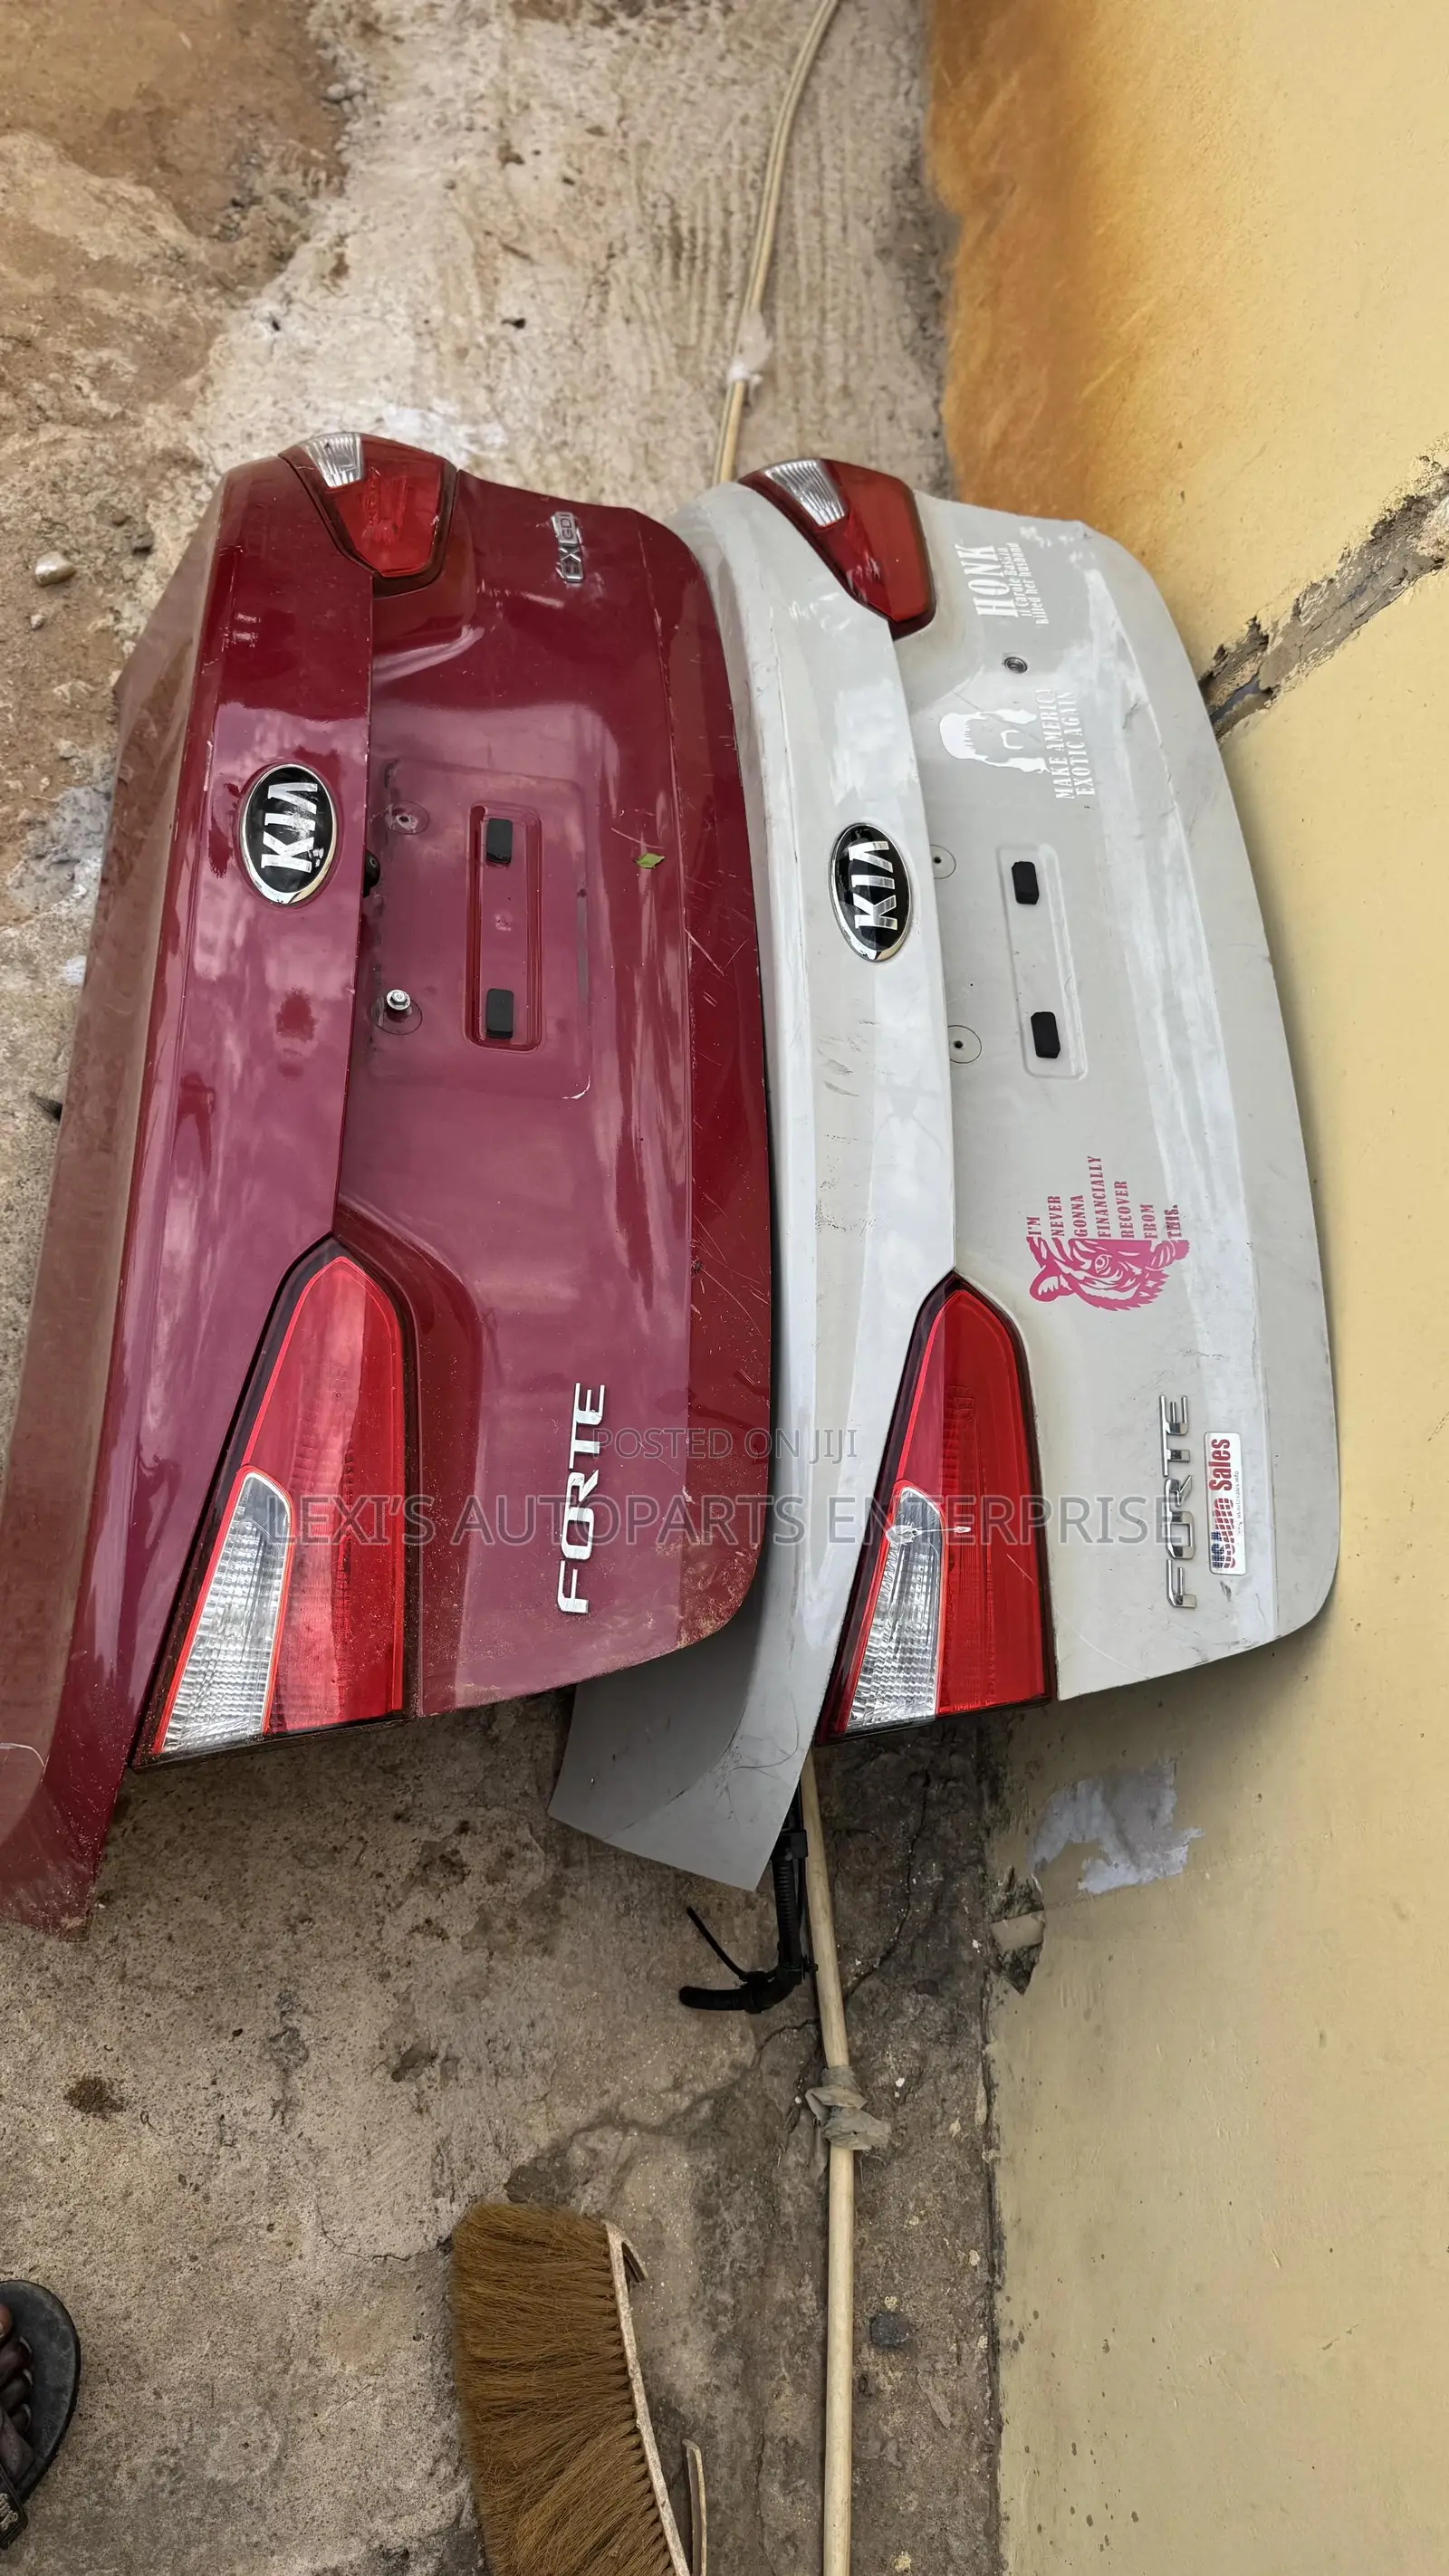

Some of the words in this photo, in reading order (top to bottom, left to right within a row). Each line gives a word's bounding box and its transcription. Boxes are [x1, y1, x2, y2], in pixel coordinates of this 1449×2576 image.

[559, 512, 575, 541] GDI
[557, 546, 584, 581] EX
[955, 543, 1019, 618] HONK
[1006, 542, 1032, 577] husband
[1008, 578, 1029, 607] Carole
[1022, 579, 1039, 594] her
[1057, 691, 1083, 736] AGAIN
[1049, 757, 1075, 799] MAKE
[1066, 742, 1095, 796] EXOTIC
[261, 782, 318, 873] KIA
[848, 840, 898, 931] KIA
[1047, 1195, 1065, 1237] NEVER
[1070, 1194, 1088, 1238] GONNA
[1087, 1155, 1111, 1238] FINANCIALLY
[1114, 1181, 1135, 1239] RECOVER
[1026, 1216, 1041, 1237] I'M
[1139, 1203, 1158, 1239] FROM
[1164, 1204, 1182, 1240] THIS.
[1207, 1438, 1233, 1491] Sales
[557, 1383, 606, 1614] FORTE
[1159, 1394, 1196, 1608] FORTE
